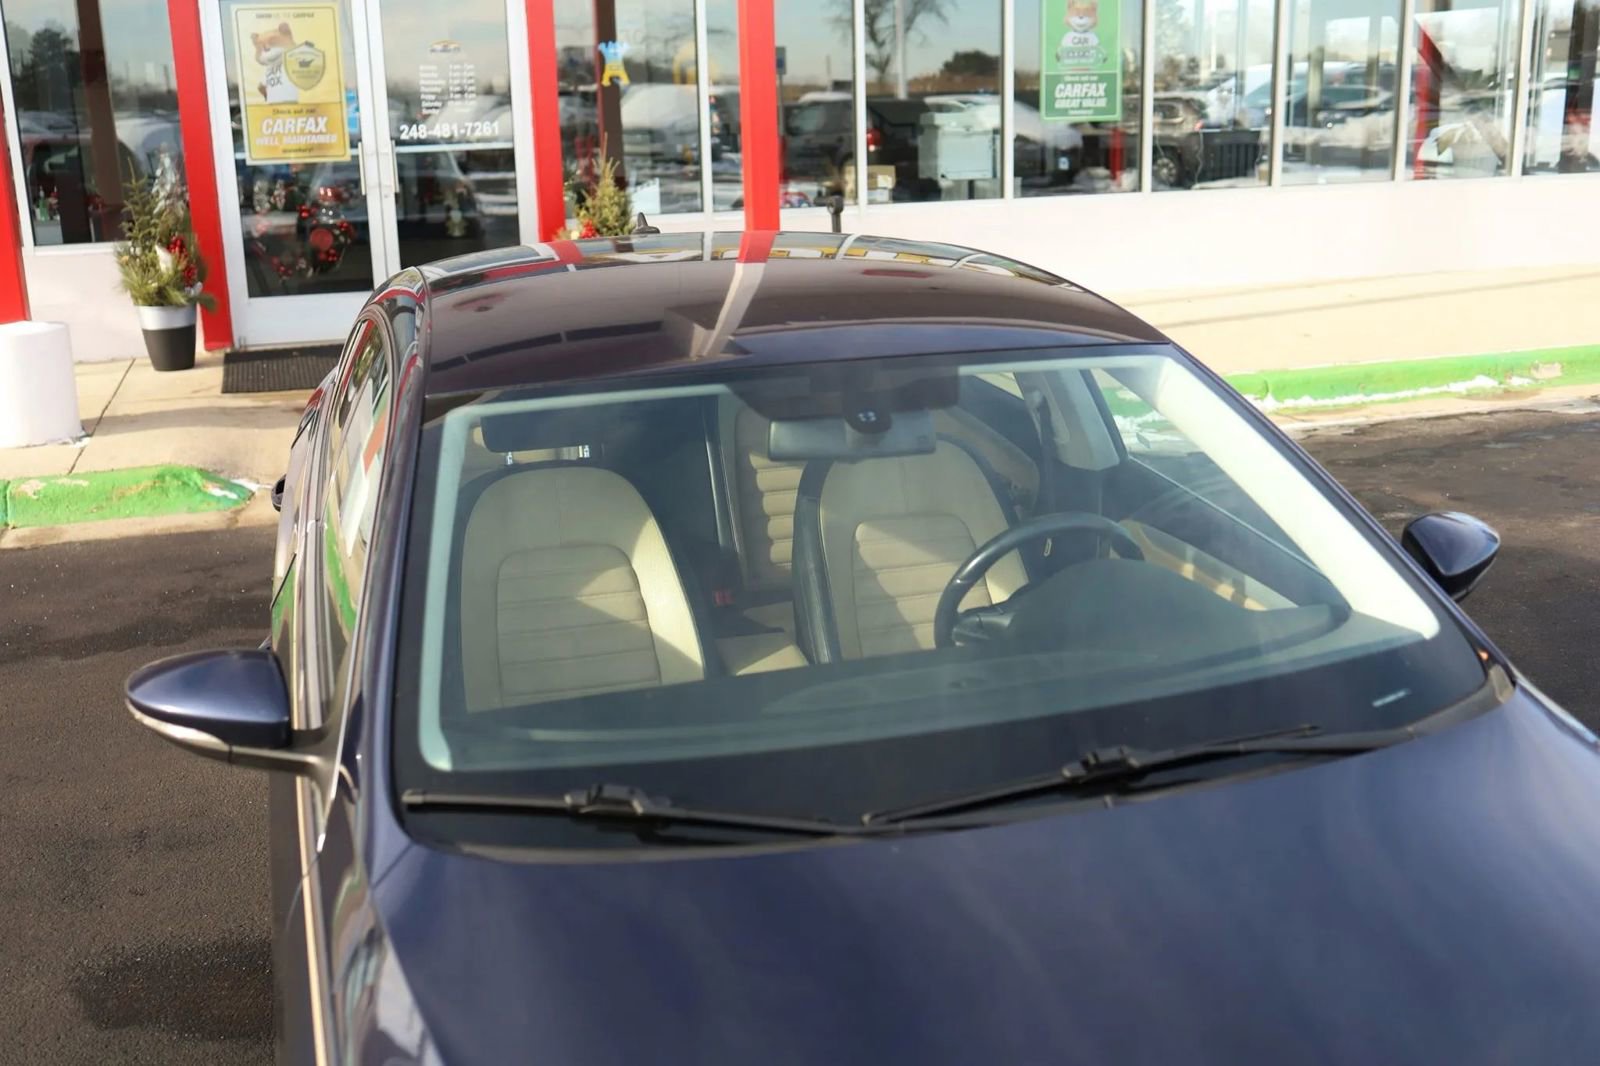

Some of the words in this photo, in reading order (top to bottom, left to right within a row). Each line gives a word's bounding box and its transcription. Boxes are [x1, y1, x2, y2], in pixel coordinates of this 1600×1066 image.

[1055, 82, 1107, 98] CARFAX
[262, 115, 328, 136] CARFAX
[399, 121, 500, 140] 248-481-7261
